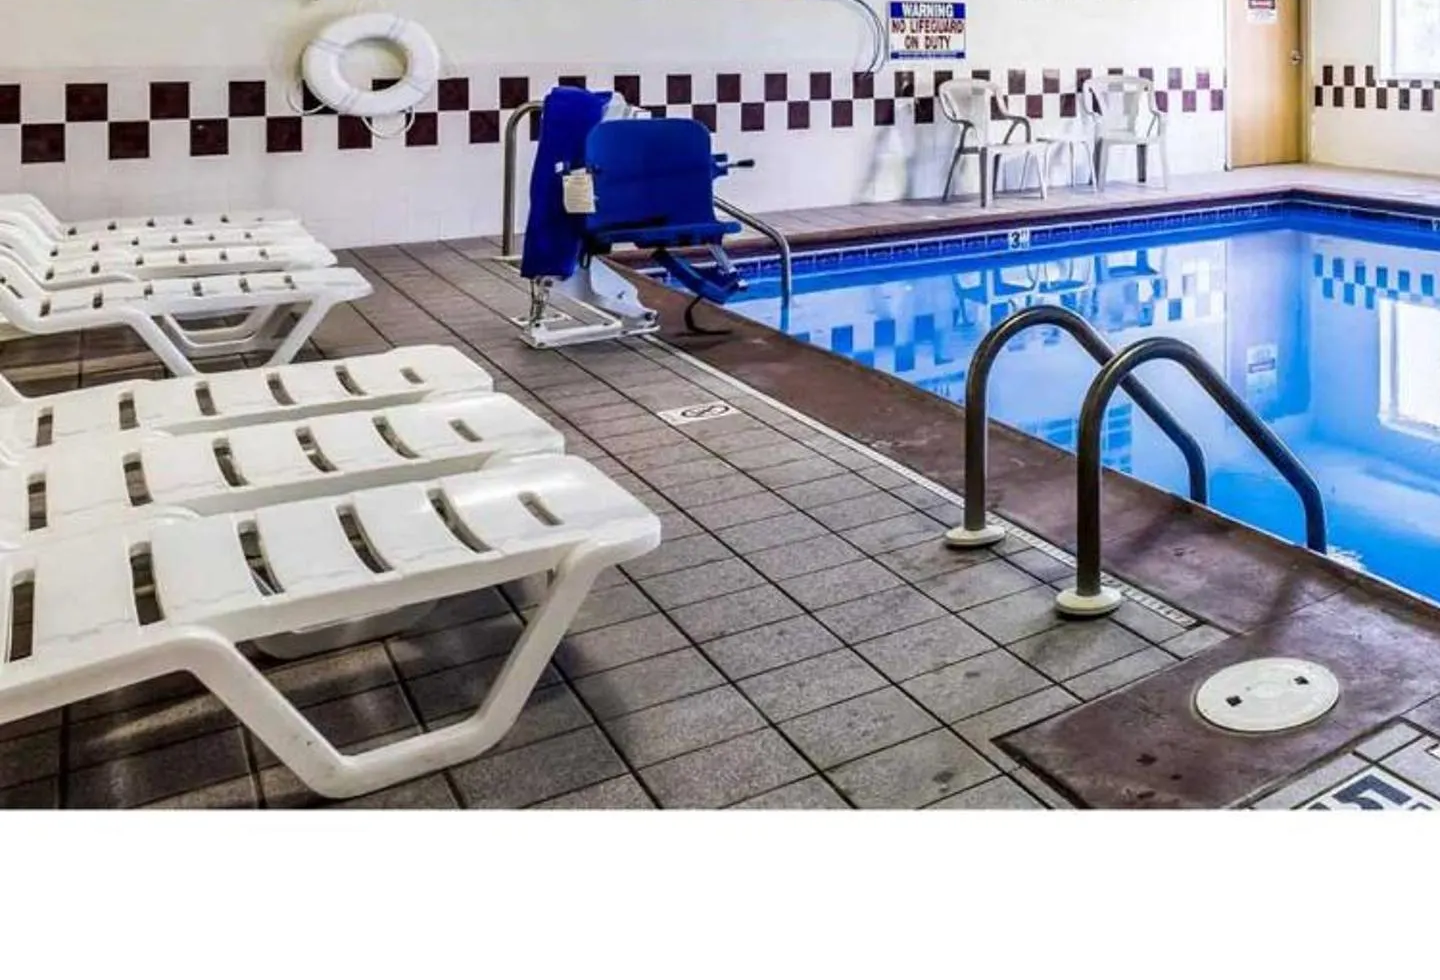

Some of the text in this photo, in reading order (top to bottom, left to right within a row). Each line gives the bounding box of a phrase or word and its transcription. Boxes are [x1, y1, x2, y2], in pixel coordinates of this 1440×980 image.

[902, 3, 954, 18] WARNING
[891, 19, 963, 33] NO LIFEGUARD
[904, 35, 951, 49] ON DUTY
